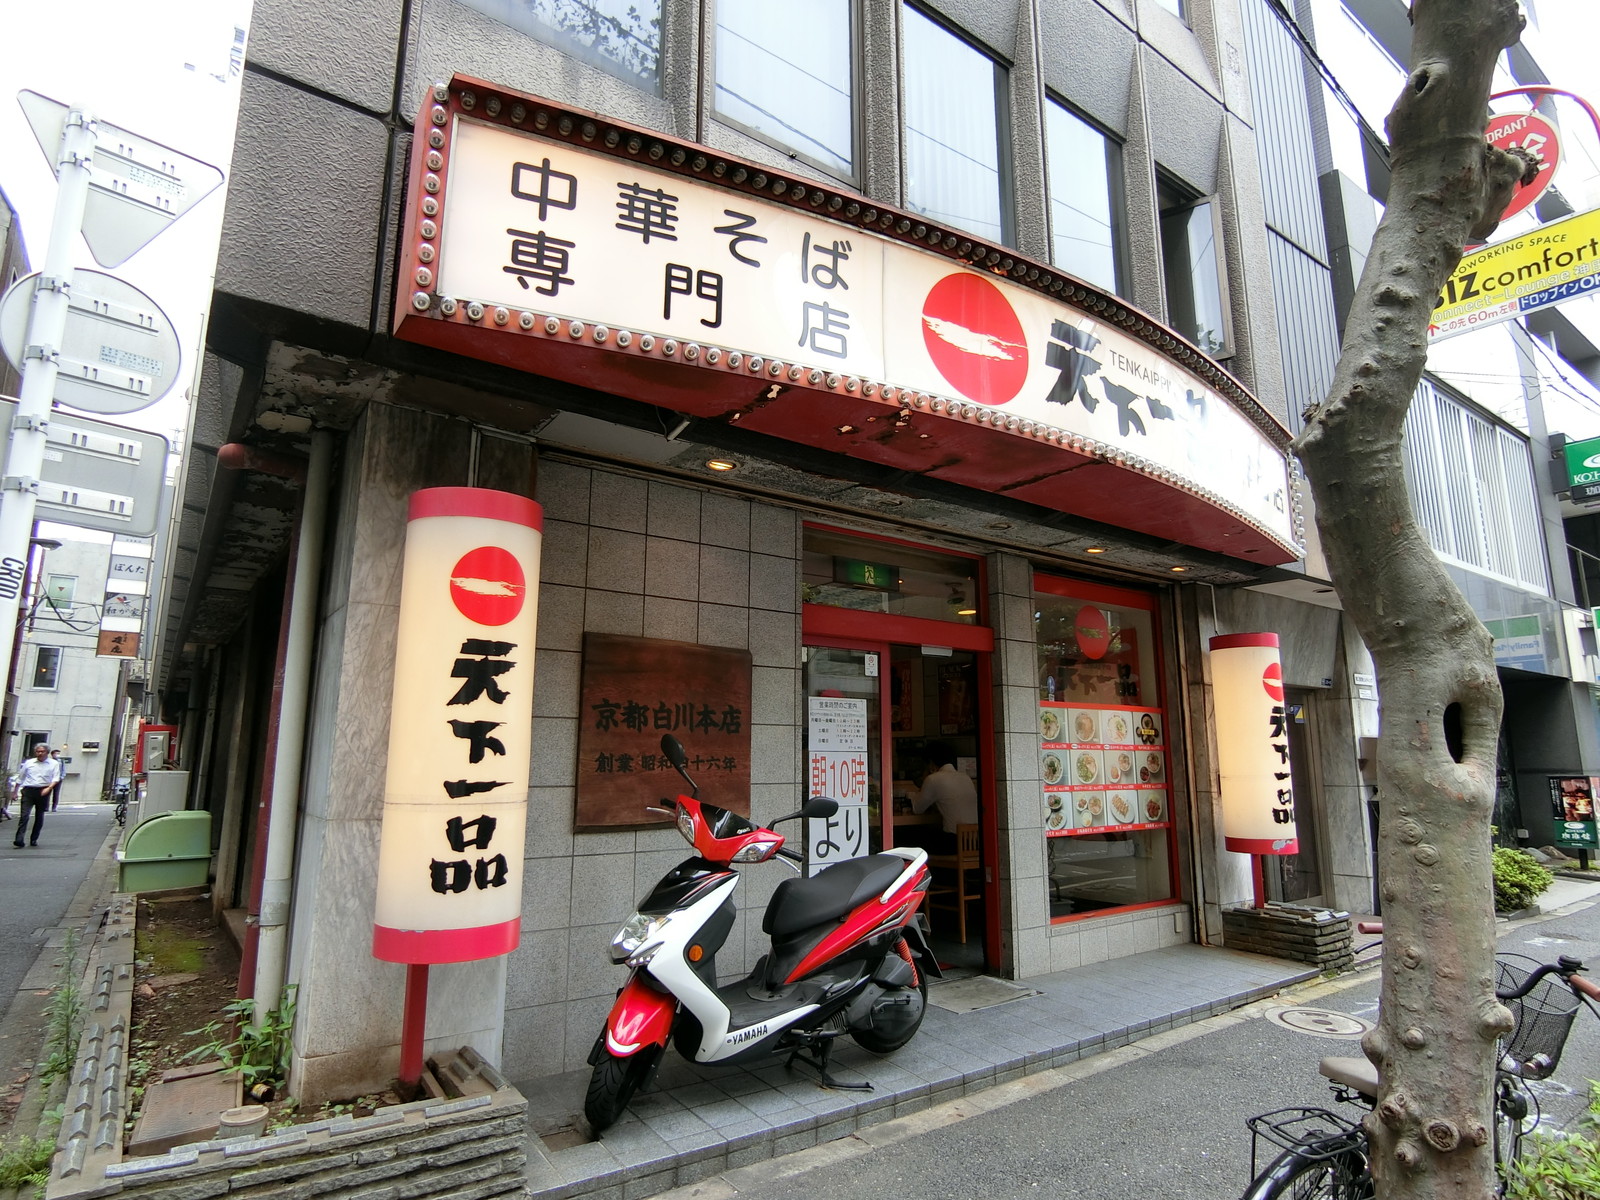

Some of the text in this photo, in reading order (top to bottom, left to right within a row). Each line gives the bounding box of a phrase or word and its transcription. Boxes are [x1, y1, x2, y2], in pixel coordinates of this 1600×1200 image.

[511, 158, 852, 291] 中華そば
[1452, 233, 1567, 278] COWORKING SPACE
[502, 228, 850, 360] 専門店
[1431, 270, 1571, 322] onnect-Lounge
[1045, 318, 1207, 437] 天下一
[1110, 350, 1172, 394] TENKAIPPI
[592, 698, 742, 734] 京都白川本店
[430, 638, 518, 895] 天下一品
[595, 752, 635, 774] 創業
[811, 753, 866, 803] 朝10時
[815, 807, 862, 859] より
[732, 1024, 769, 1046] YAMAHA
